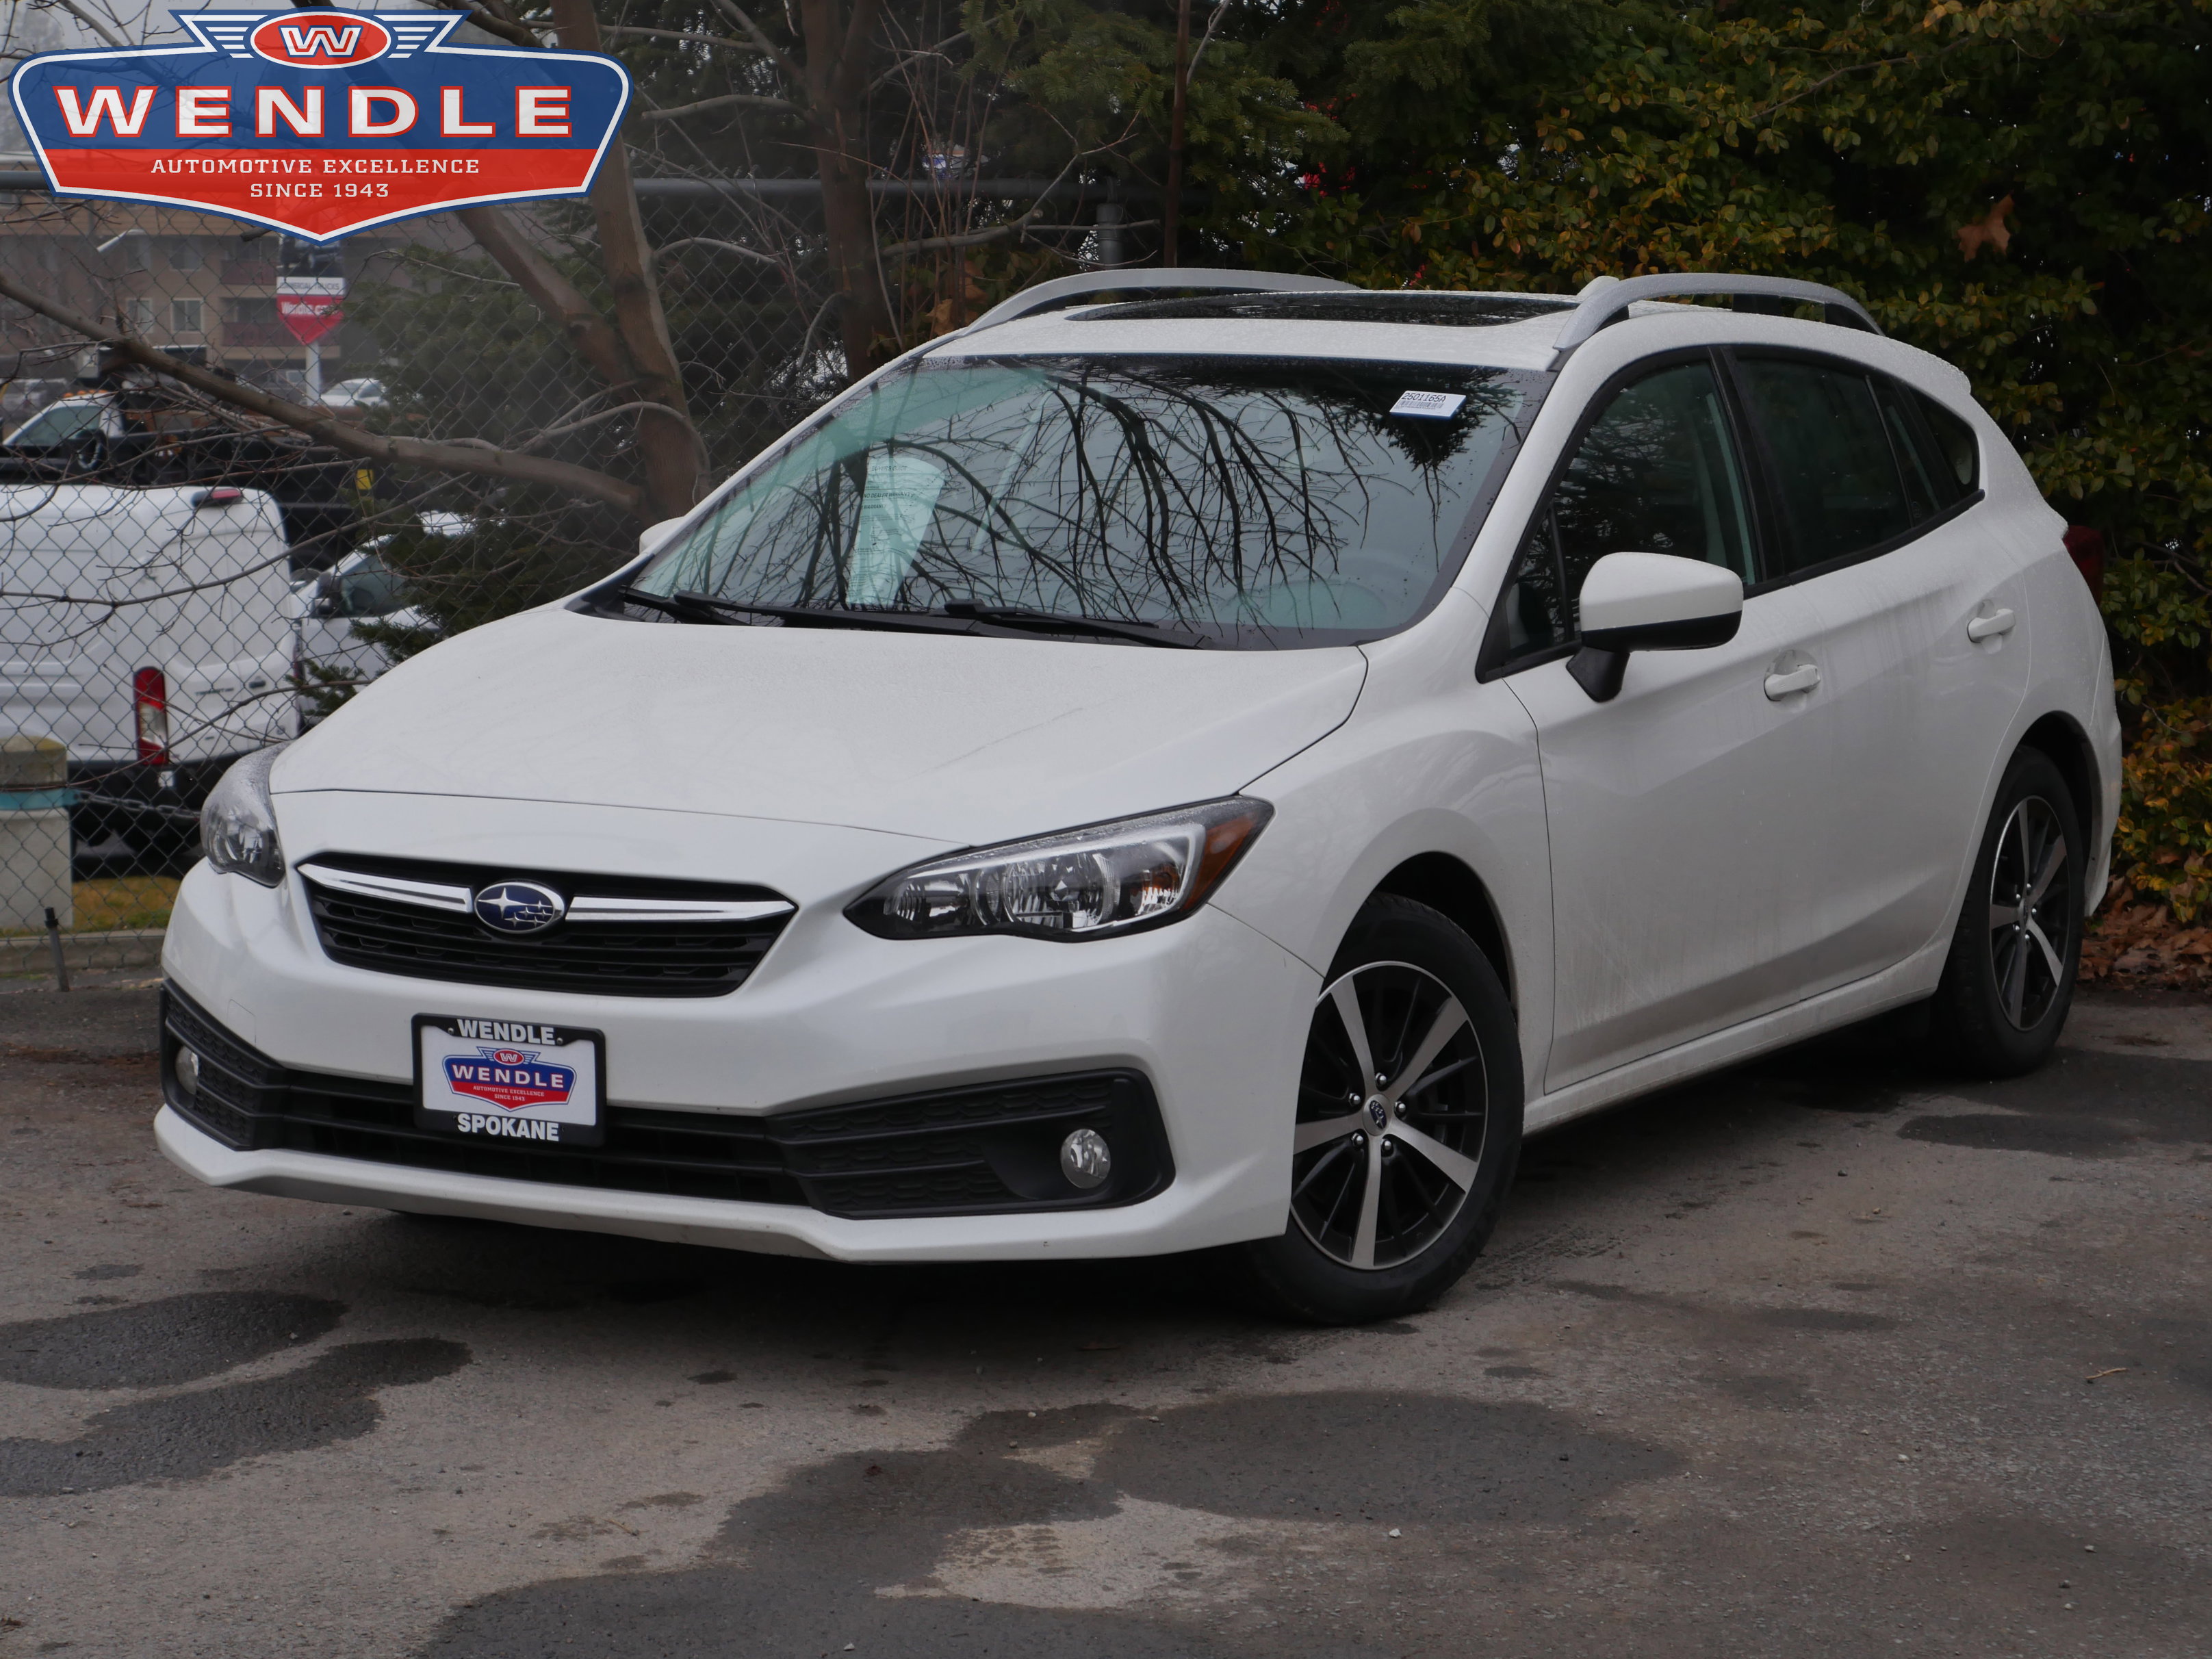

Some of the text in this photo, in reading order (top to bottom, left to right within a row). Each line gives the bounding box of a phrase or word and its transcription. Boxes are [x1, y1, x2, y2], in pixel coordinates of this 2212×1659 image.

[1402, 392, 1446, 402] 2501165A
[456, 1018, 556, 1045] WENDLE
[452, 1064, 564, 1088] WENDLE
[510, 1088, 545, 1097] EXCELLENCE
[457, 1113, 559, 1142] SPOKANE
